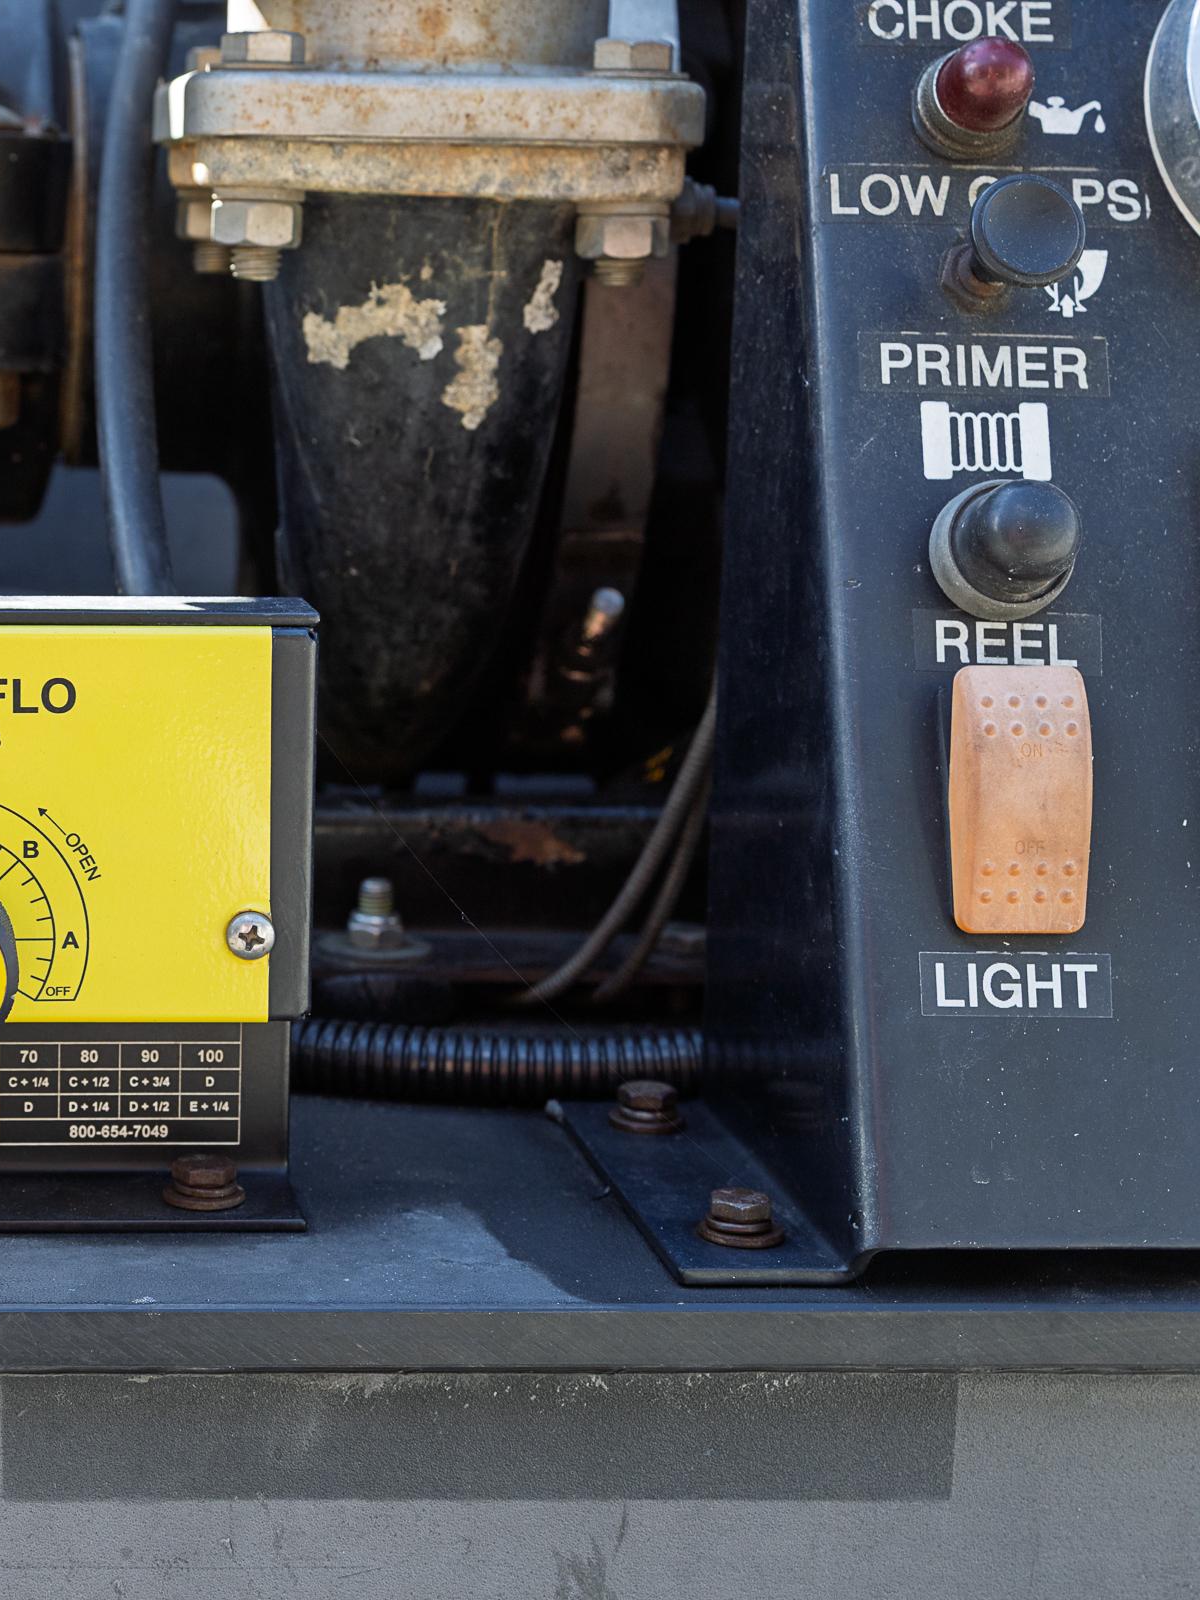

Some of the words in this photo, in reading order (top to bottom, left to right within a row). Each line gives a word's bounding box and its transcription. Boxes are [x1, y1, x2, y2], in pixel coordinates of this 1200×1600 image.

[867, 0, 1055, 42] CHOKE
[829, 173, 951, 217] LOW
[879, 342, 1089, 391] PRIMER
[935, 619, 1078, 668] REEL
[1020, 742, 1044, 758] ON
[22, 840, 40, 859] B
[1014, 840, 1046, 855] OFF
[65, 833, 102, 882] OPEN
[61, 931, 80, 950] A
[45, 985, 71, 997] OFF
[934, 962, 1098, 1009] LIGHT
[19, 1049, 38, 1064] 70
[80, 1049, 99, 1064] 80
[141, 1049, 160, 1063] 90
[197, 1049, 224, 1063] 100
[8, 1076, 18, 1088] C
[31, 1076, 50, 1088] 1/4
[68, 1076, 78, 1088] C
[92, 1076, 110, 1088] 1/2
[129, 1075, 139, 1088] C
[152, 1076, 171, 1088] 3/4
[205, 1075, 215, 1088] D
[23, 1101, 34, 1113] D
[68, 1101, 79, 1113] D
[92, 1101, 110, 1112] 1/4
[129, 1100, 139, 1112] D
[152, 1100, 170, 1112] 1/2
[189, 1100, 199, 1112] E
[212, 1101, 230, 1112] 1/4
[69, 1124, 169, 1139] 800-654-7049
